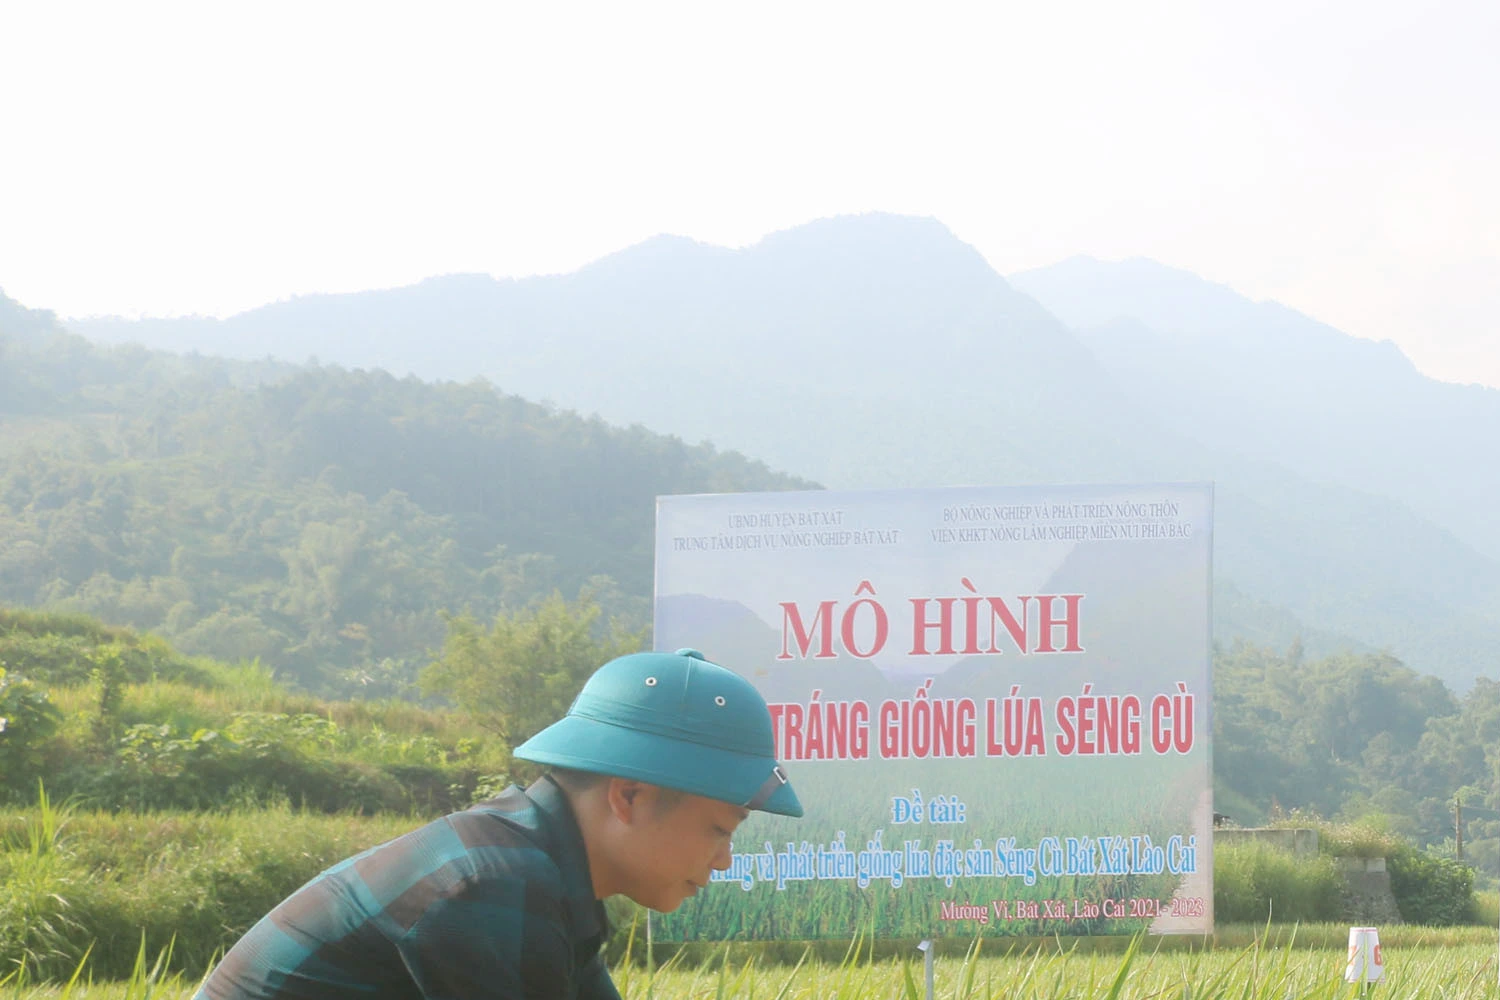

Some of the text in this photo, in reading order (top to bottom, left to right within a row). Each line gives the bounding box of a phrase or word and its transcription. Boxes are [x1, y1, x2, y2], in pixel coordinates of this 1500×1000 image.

[728, 513, 758, 528] UBND
[1034, 500, 1050, 519] VÀ
[1052, 500, 1079, 519] PHÁT
[672, 536, 709, 551] TRUNG
[959, 527, 989, 542] KHKT
[777, 577, 1085, 659] MÔ HÌNH
[767, 679, 1194, 760] TRÁNG GIỐNG LÚA SÉNG CÙ
[892, 790, 965, 822] Đề tài:
[756, 842, 775, 880] và
[778, 841, 814, 889] phát
[818, 832, 856, 878] triển
[858, 831, 902, 887] giống
[905, 840, 930, 876] lúa
[934, 841, 963, 886] đặc
[966, 839, 994, 876] sản
[996, 838, 1035, 885] Séng
[1039, 837, 1063, 875] Cù
[1066, 837, 1095, 874] Bát
[1098, 836, 1129, 874] Xát
[1131, 836, 1164, 873] Lào
[1167, 836, 1196, 873] Cai
[940, 900, 989, 924] Mường
[1016, 899, 1040, 919] Bát
[1042, 899, 1070, 922] Xát,
[1073, 899, 1100, 918] Lào
[1102, 898, 1126, 918] Cai
[1171, 897, 1204, 918] 2023
